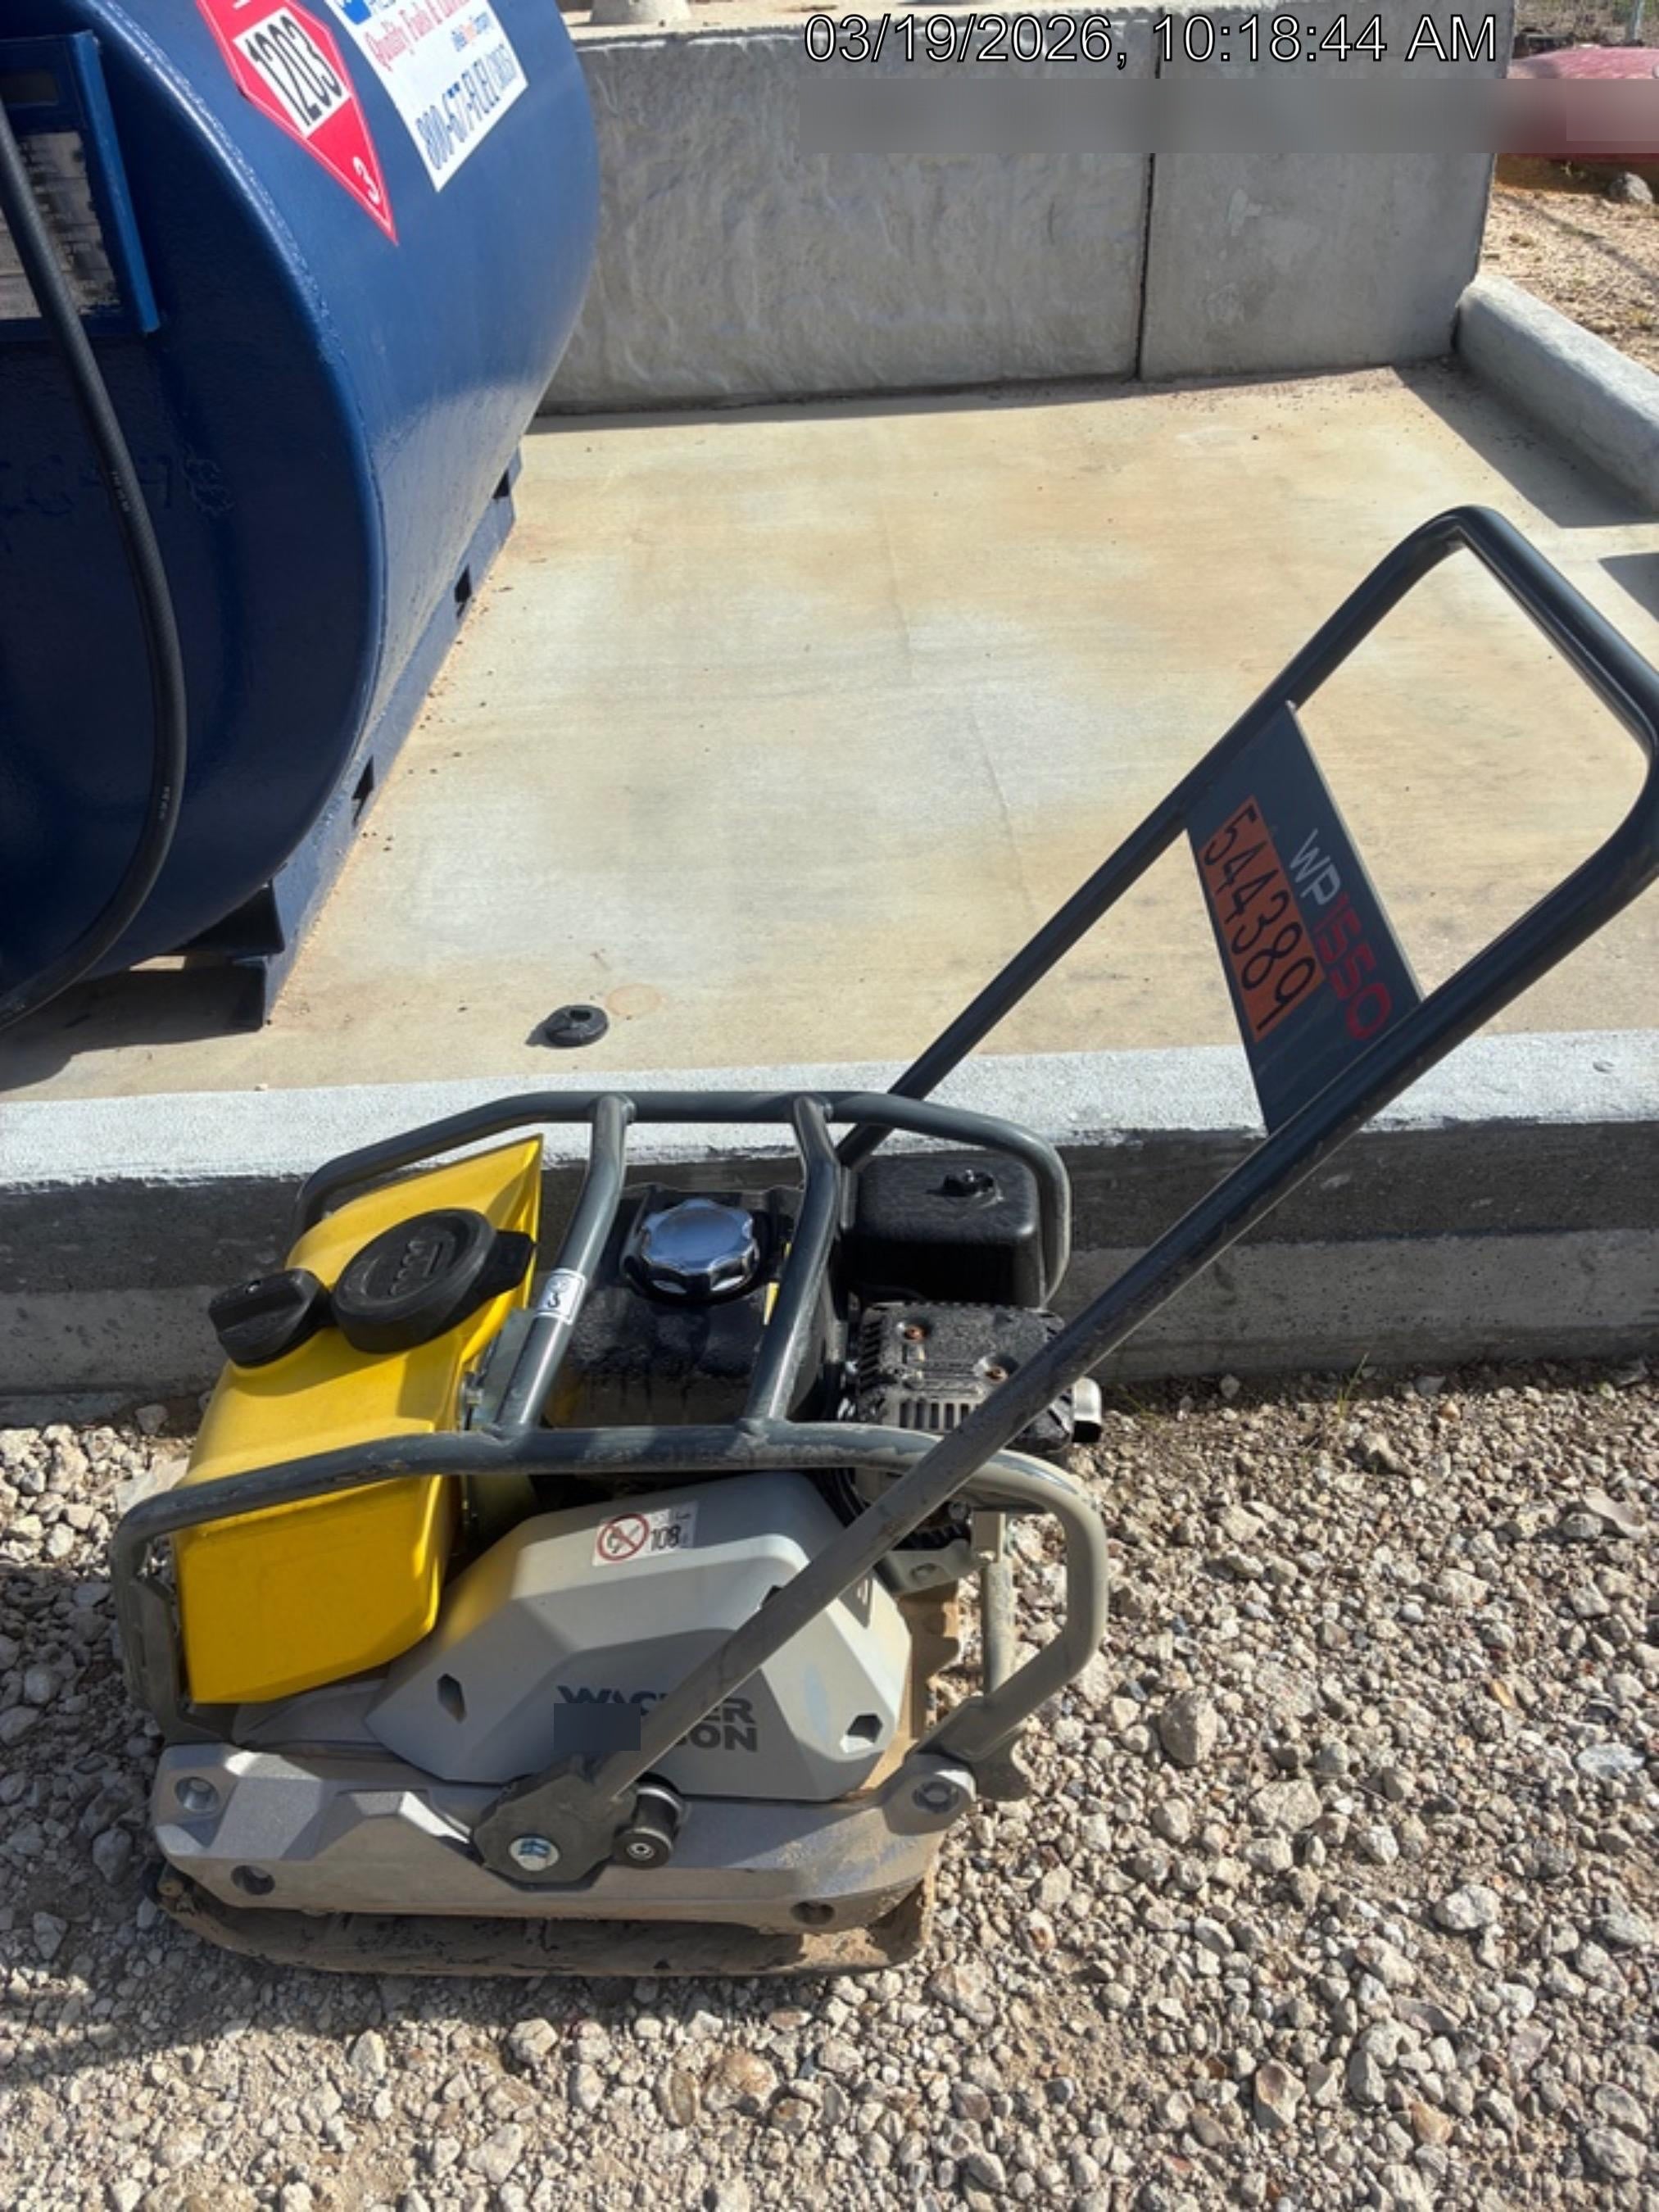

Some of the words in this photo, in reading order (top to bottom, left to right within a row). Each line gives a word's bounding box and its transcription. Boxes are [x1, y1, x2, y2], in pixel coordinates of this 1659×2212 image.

[245, 15, 342, 127] 1203
[353, 156, 381, 205] 3
[1203, 801, 1317, 1032] 544389
